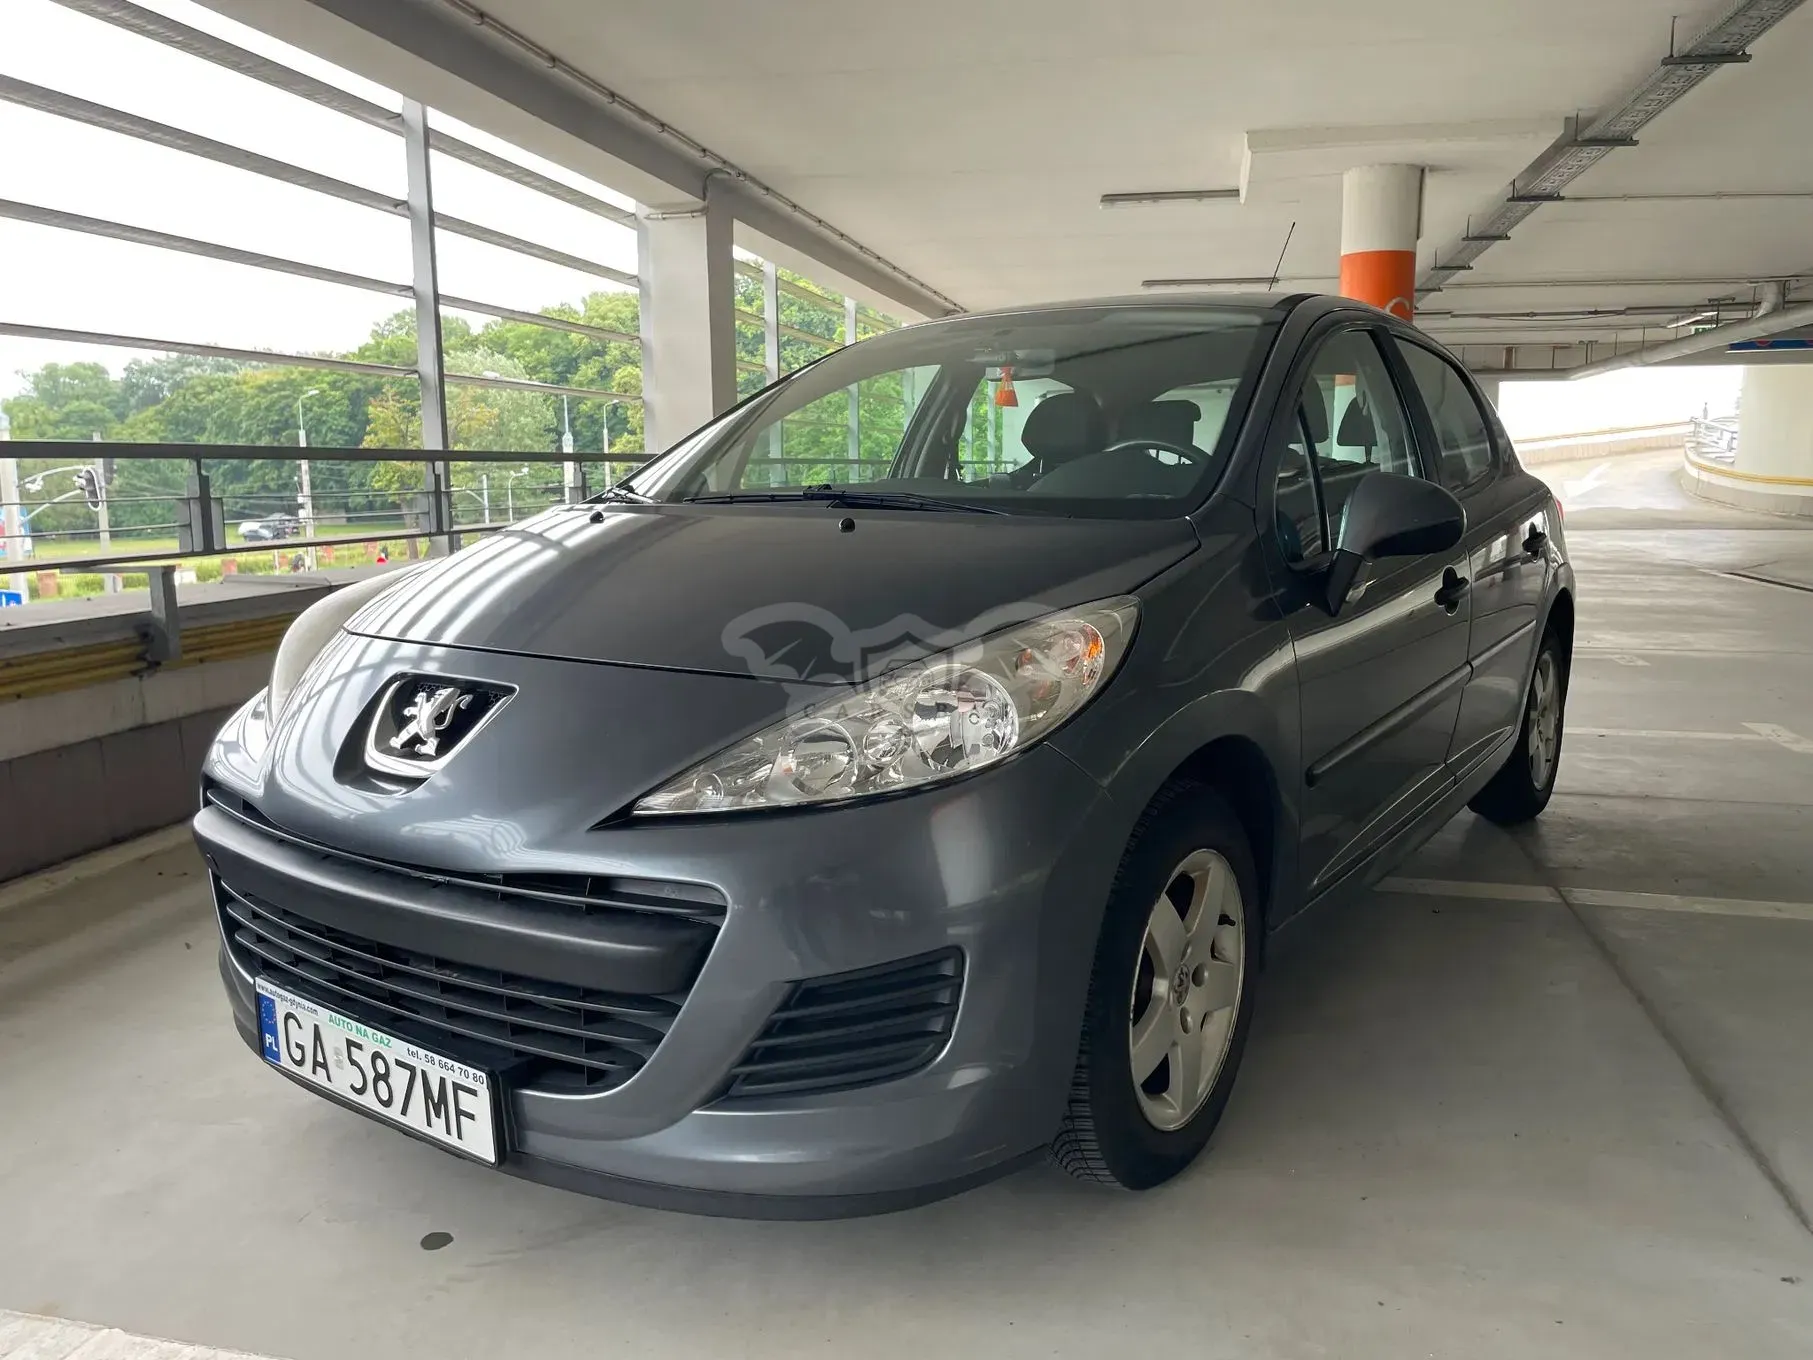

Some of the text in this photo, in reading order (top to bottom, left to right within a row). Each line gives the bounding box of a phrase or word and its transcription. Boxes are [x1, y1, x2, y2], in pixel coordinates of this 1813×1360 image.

[265, 1032, 279, 1052] PL
[329, 1014, 393, 1048] AUTO NA GAZ
[283, 1011, 479, 1141] GA 587MF
[407, 1047, 485, 1085] tel. 58 664 70 80
